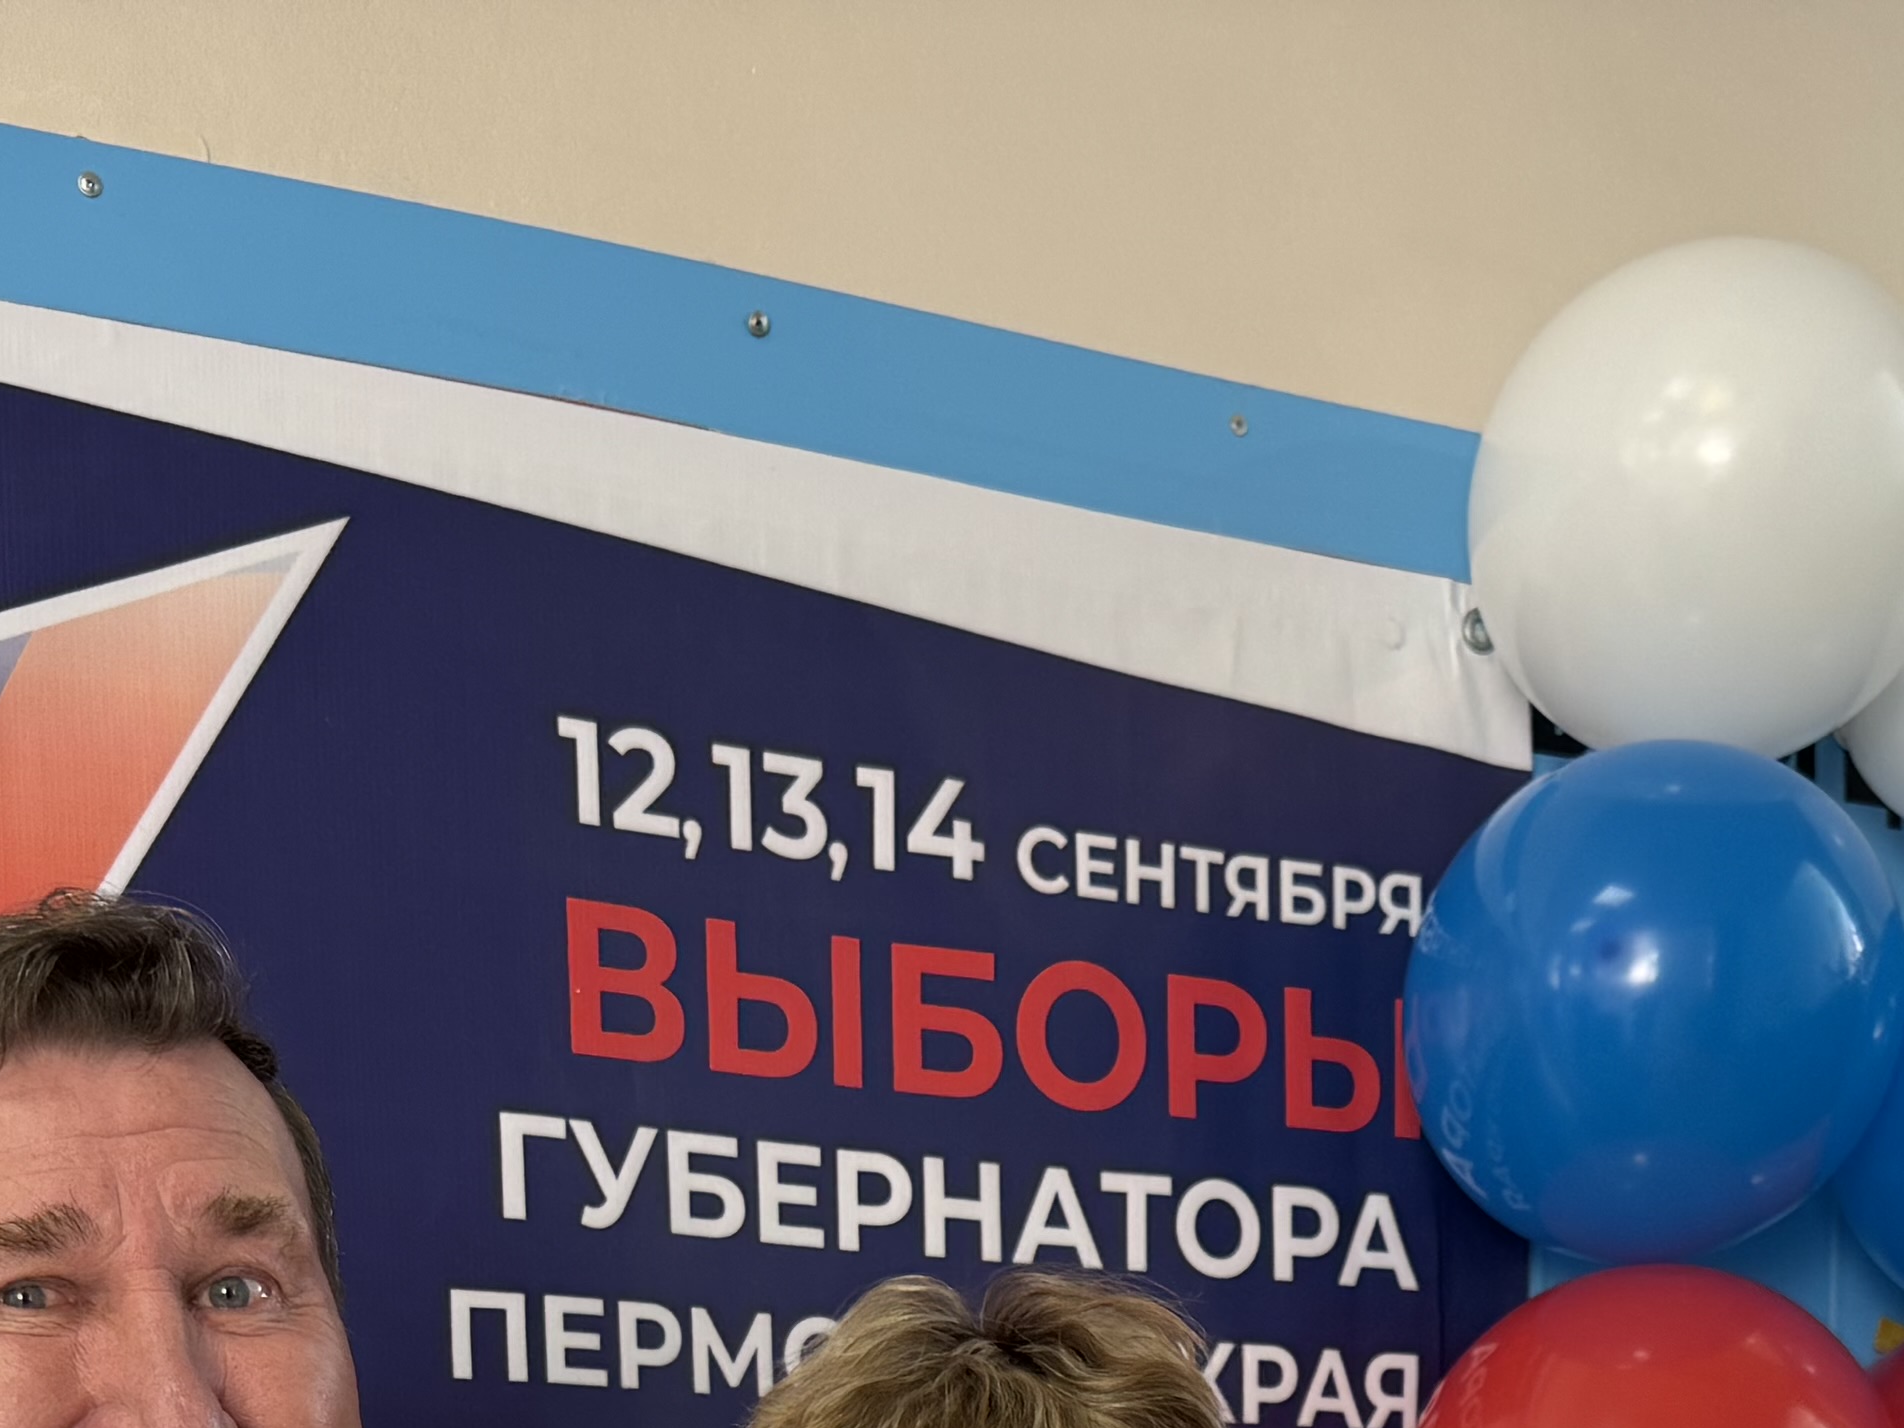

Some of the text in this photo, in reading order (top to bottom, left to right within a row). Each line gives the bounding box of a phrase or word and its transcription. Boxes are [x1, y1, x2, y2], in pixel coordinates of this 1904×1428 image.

[556, 714, 1423, 938] 12,13,14 СЕНТЯБРЯ
[566, 896, 1421, 1140] ВЫБОРЫ
[498, 1111, 1419, 1292] ГУБЕРНАТОРА
